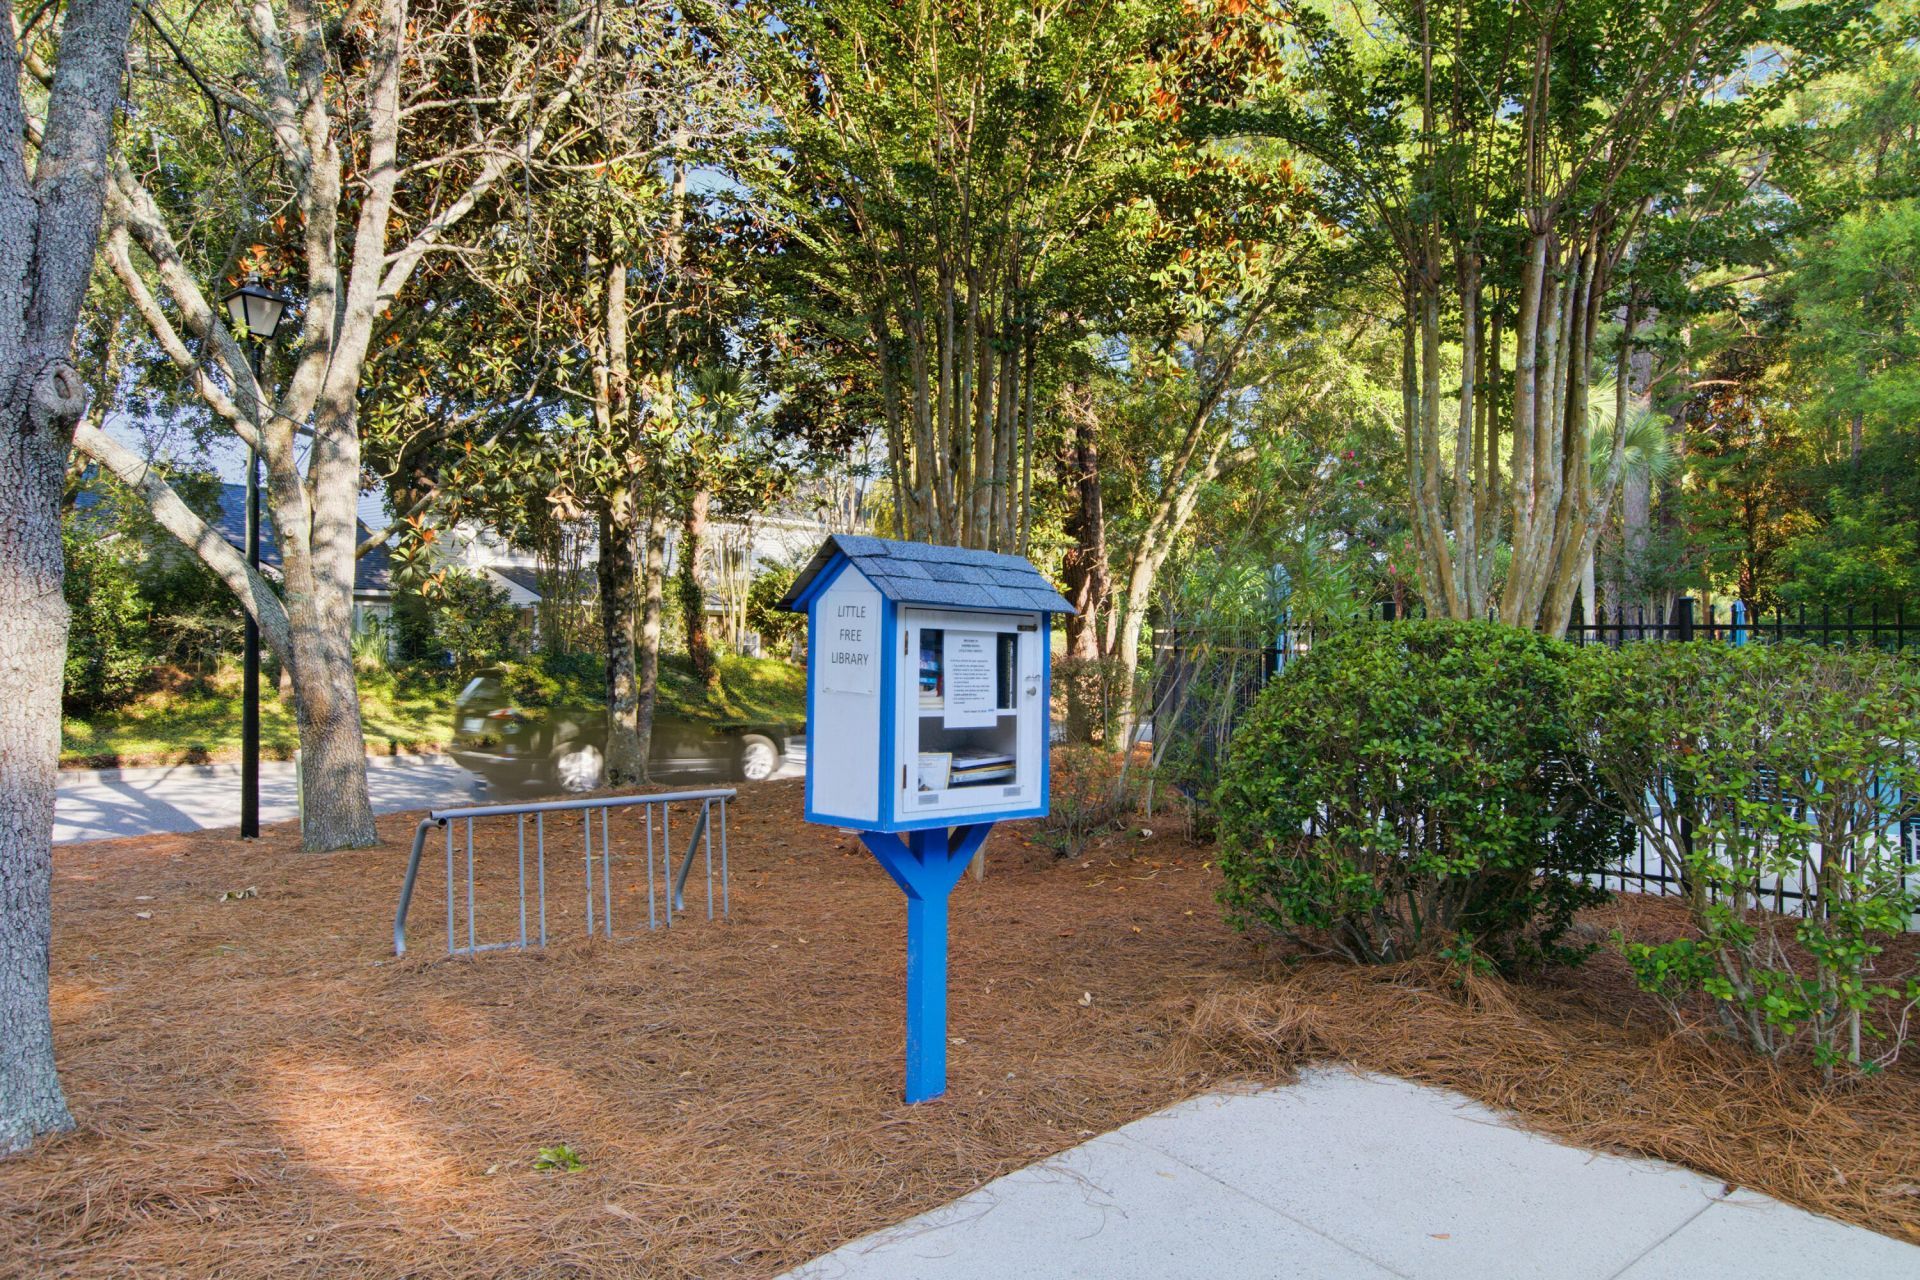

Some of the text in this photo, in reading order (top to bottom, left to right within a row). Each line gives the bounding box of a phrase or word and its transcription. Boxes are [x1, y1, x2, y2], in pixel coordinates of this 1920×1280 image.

[838, 605, 866, 618] LITTLE
[839, 628, 862, 642] FREE
[831, 651, 869, 666] LIBRARY
